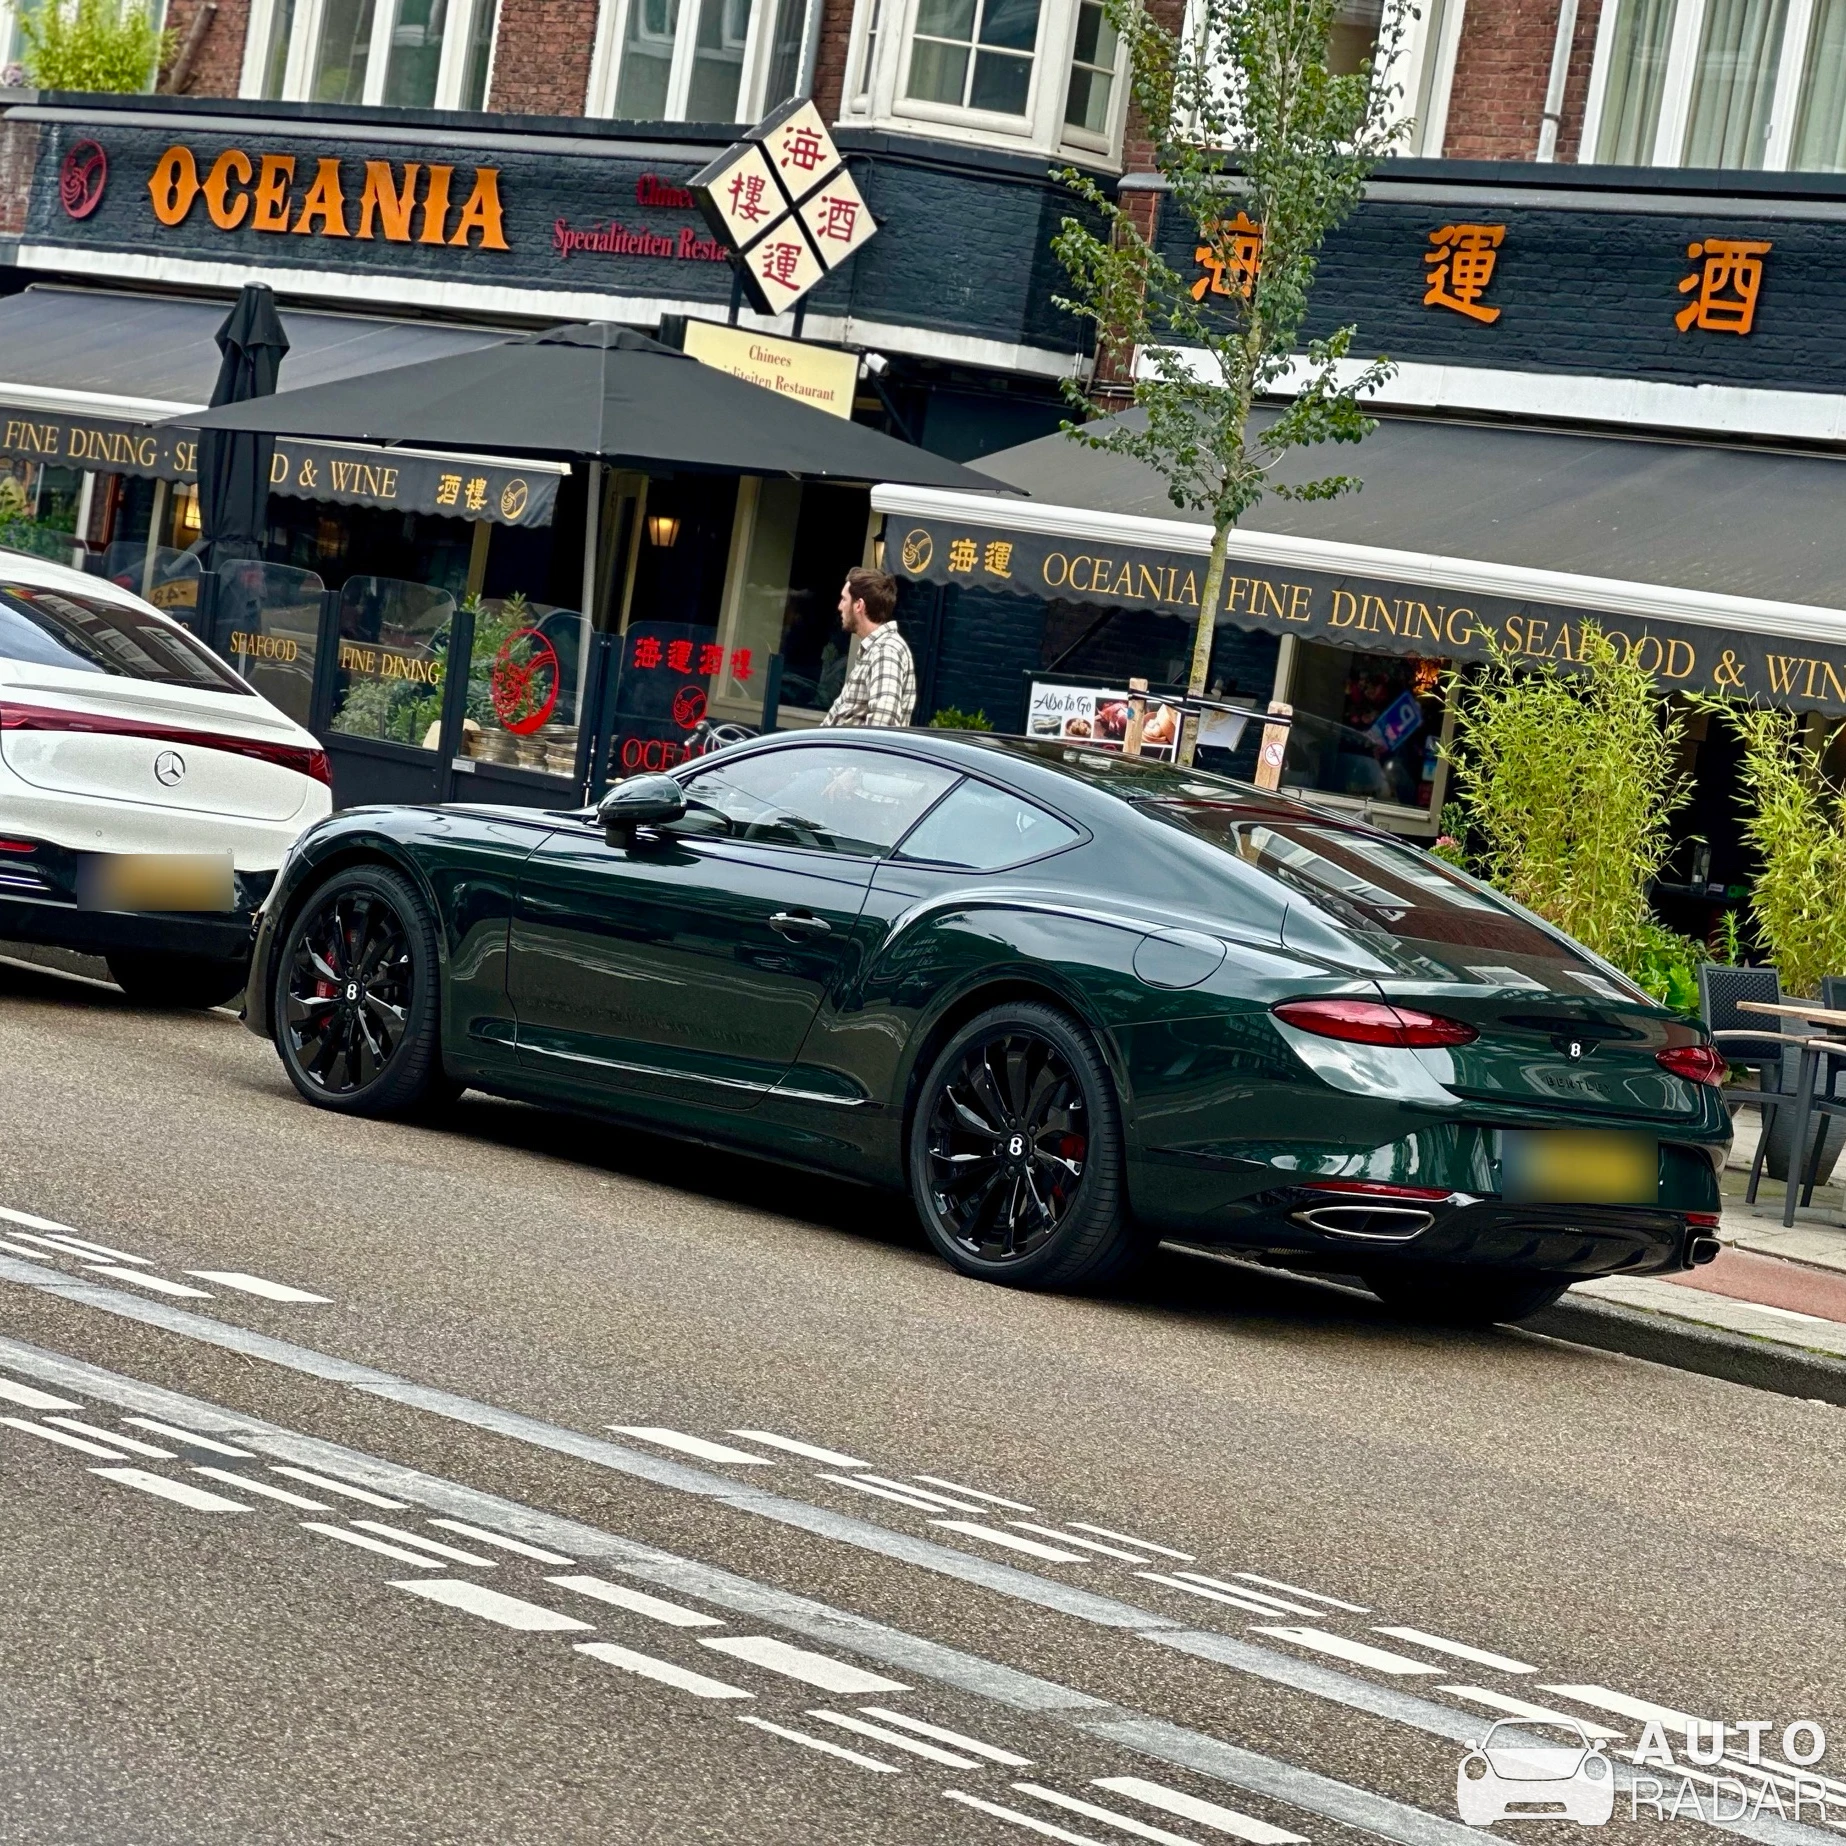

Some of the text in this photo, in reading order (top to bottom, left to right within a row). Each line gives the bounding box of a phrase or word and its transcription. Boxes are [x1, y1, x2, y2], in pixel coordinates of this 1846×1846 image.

[781, 126, 827, 171] 海
[148, 145, 510, 251] OCEANIA
[727, 172, 860, 243] 樓 酒
[552, 217, 730, 263] Specialiteiten Resta
[762, 242, 802, 291] 運
[749, 344, 792, 368] Chinees
[775, 375, 835, 402] Restaurant
[3, 420, 60, 454] FINE
[67, 428, 158, 467] DINING
[299, 459, 318, 488] &
[330, 460, 399, 498] WINE
[230, 630, 298, 663] SEAFOOD
[1043, 552, 1200, 606] OCEANIA
[1224, 576, 1313, 622] FINE
[1327, 589, 1475, 645] DINING
[1713, 649, 1746, 688] &
[1765, 654, 1846, 704] WIN
[340, 646, 441, 686] FINE DINING
[1033, 692, 1092, 716] Also to Go
[622, 737, 706, 772] OCEA
